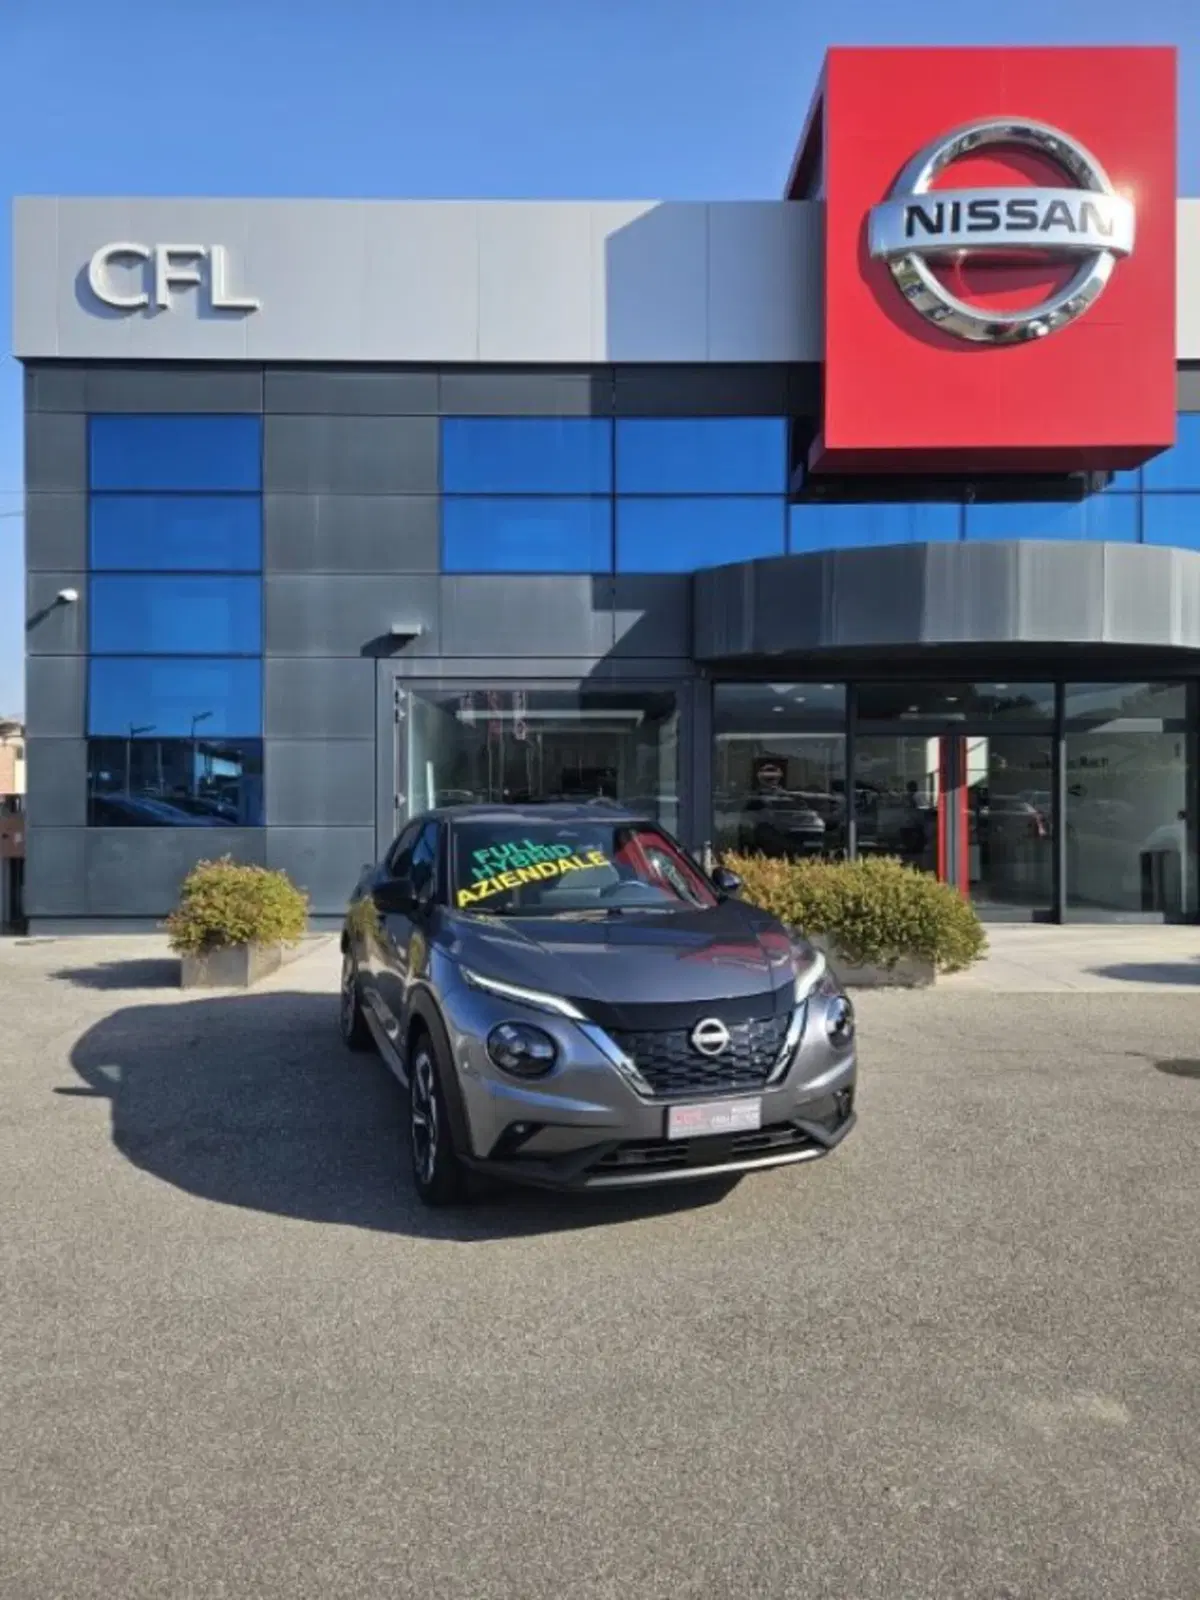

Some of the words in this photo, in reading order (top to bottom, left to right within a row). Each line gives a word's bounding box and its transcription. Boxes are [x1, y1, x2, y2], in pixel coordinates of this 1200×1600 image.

[905, 198, 1115, 237] NISSAN
[89, 242, 260, 311] CFL
[471, 843, 573, 880] HYBRID
[472, 838, 545, 865] FULL
[456, 850, 611, 907] AZIENDALE
